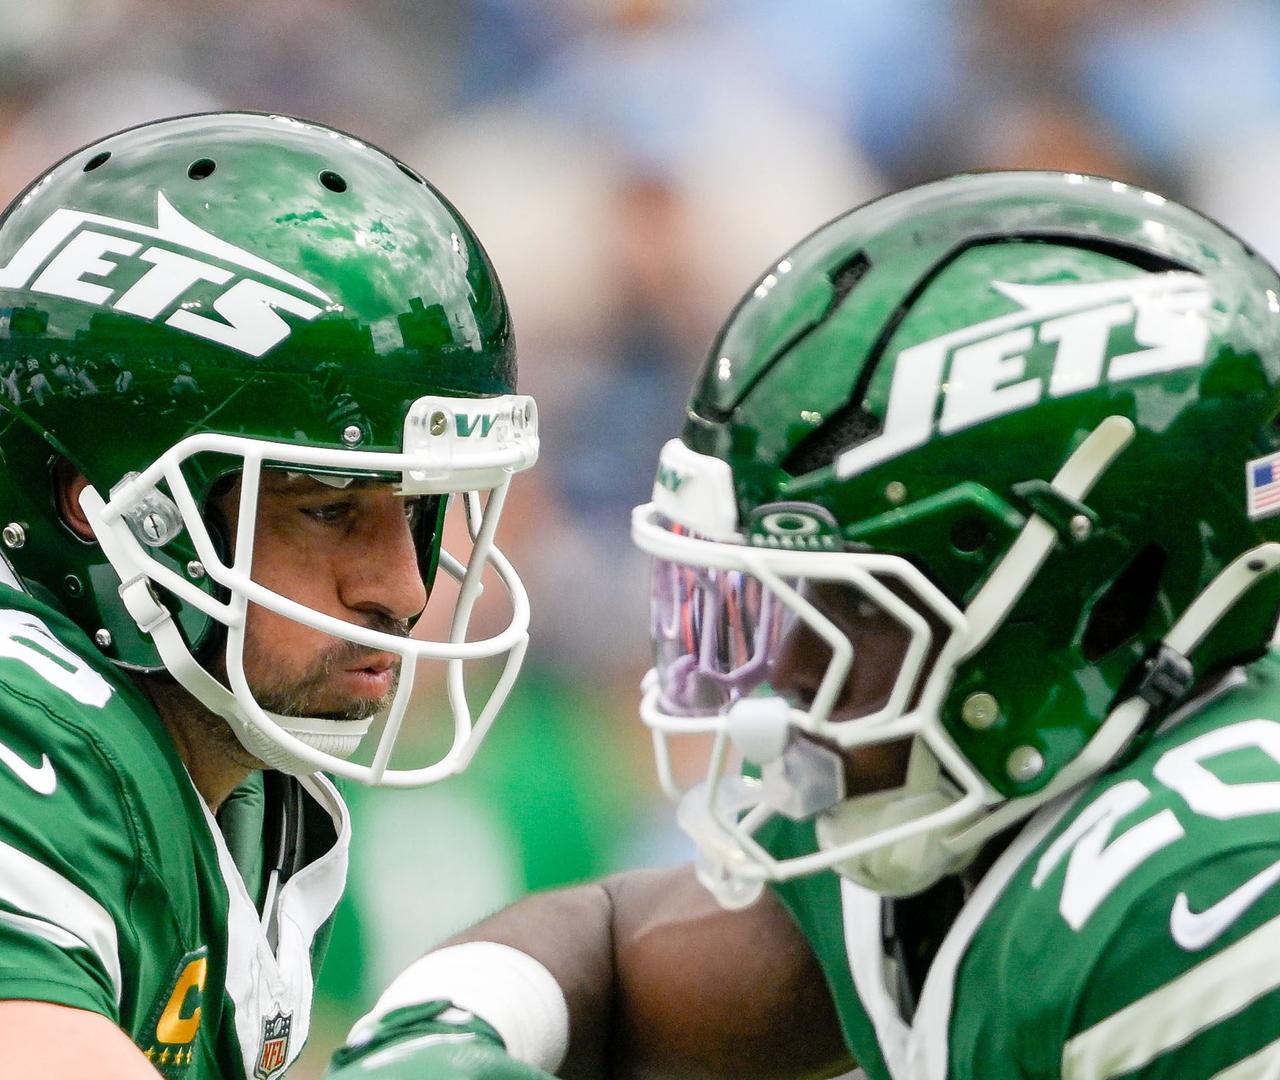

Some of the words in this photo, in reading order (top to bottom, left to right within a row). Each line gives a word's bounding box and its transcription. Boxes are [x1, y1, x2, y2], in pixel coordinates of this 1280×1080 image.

[836, 272, 1213, 480] JETS
[156, 956, 208, 1045] C
[261, 1040, 285, 1071] NFL
